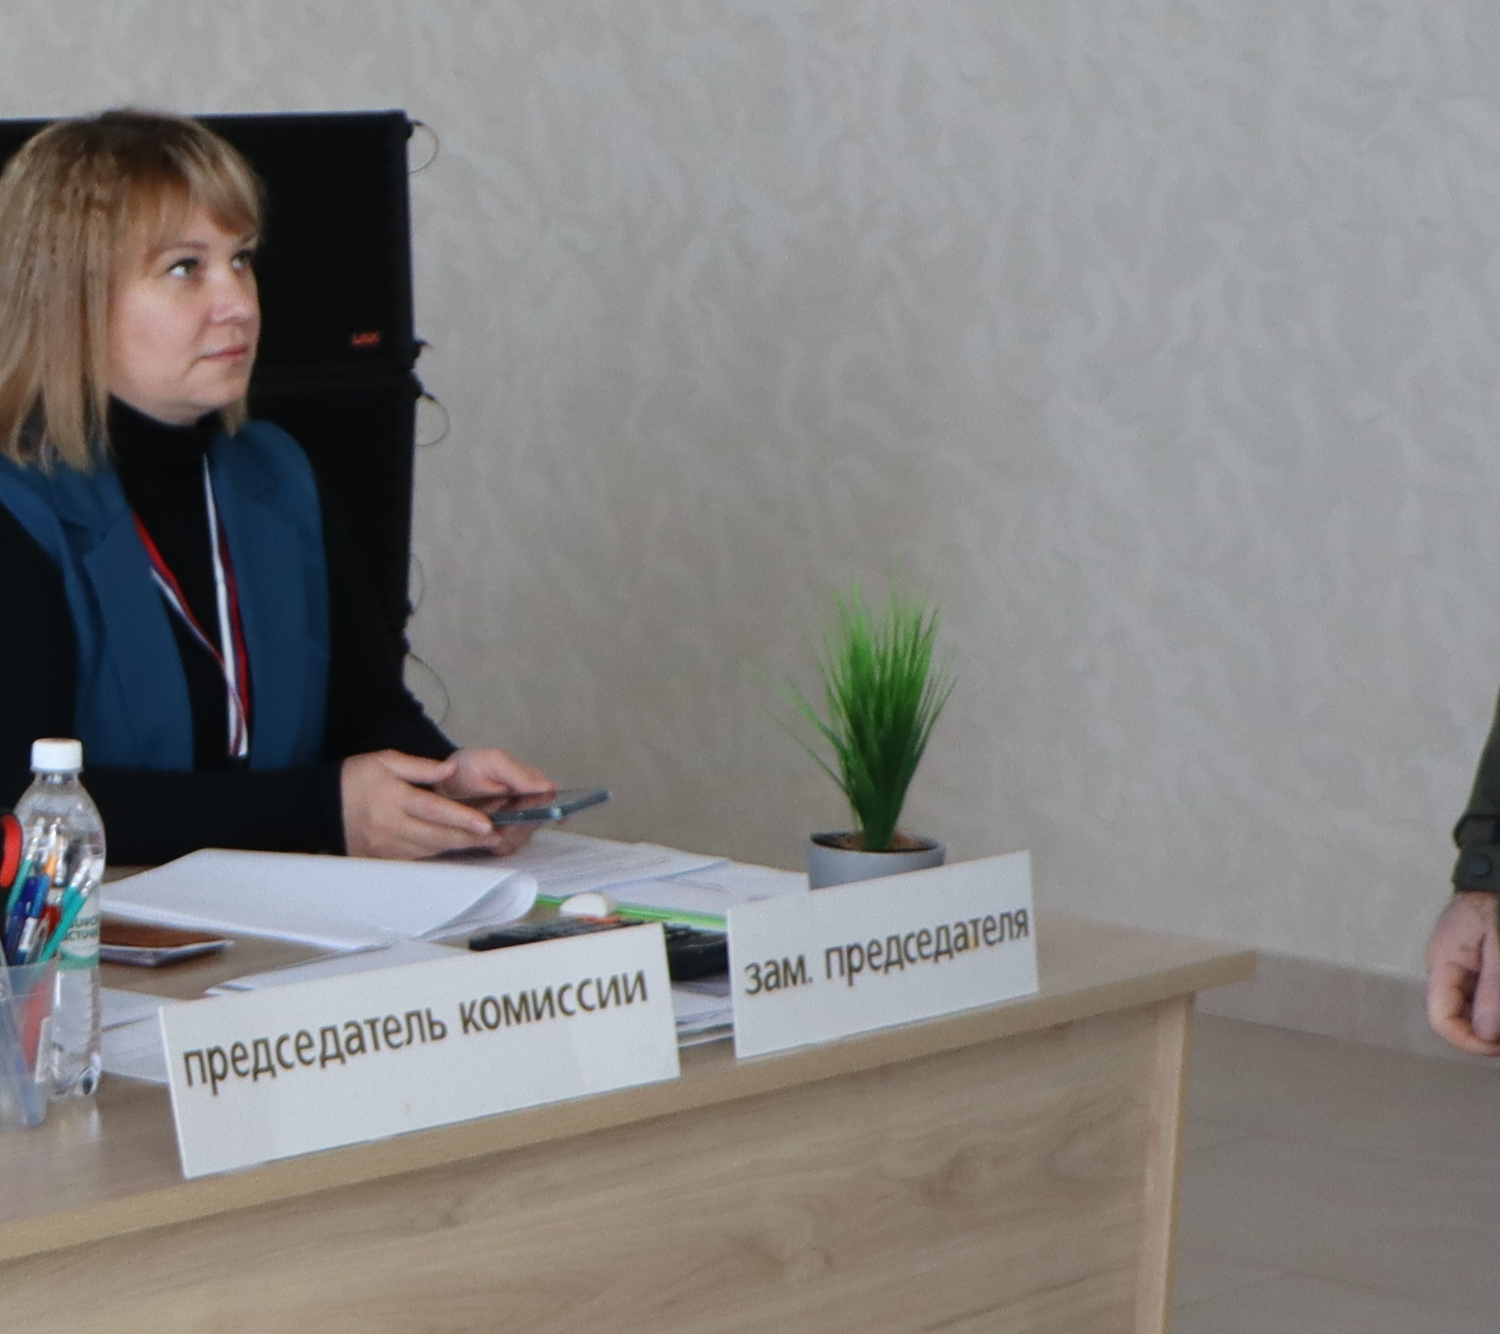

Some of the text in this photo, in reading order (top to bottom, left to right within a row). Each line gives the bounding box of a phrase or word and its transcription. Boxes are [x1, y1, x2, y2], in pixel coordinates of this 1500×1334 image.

[744, 906, 1029, 996] зам. председателя
[184, 971, 647, 1096] председатель комиссии
